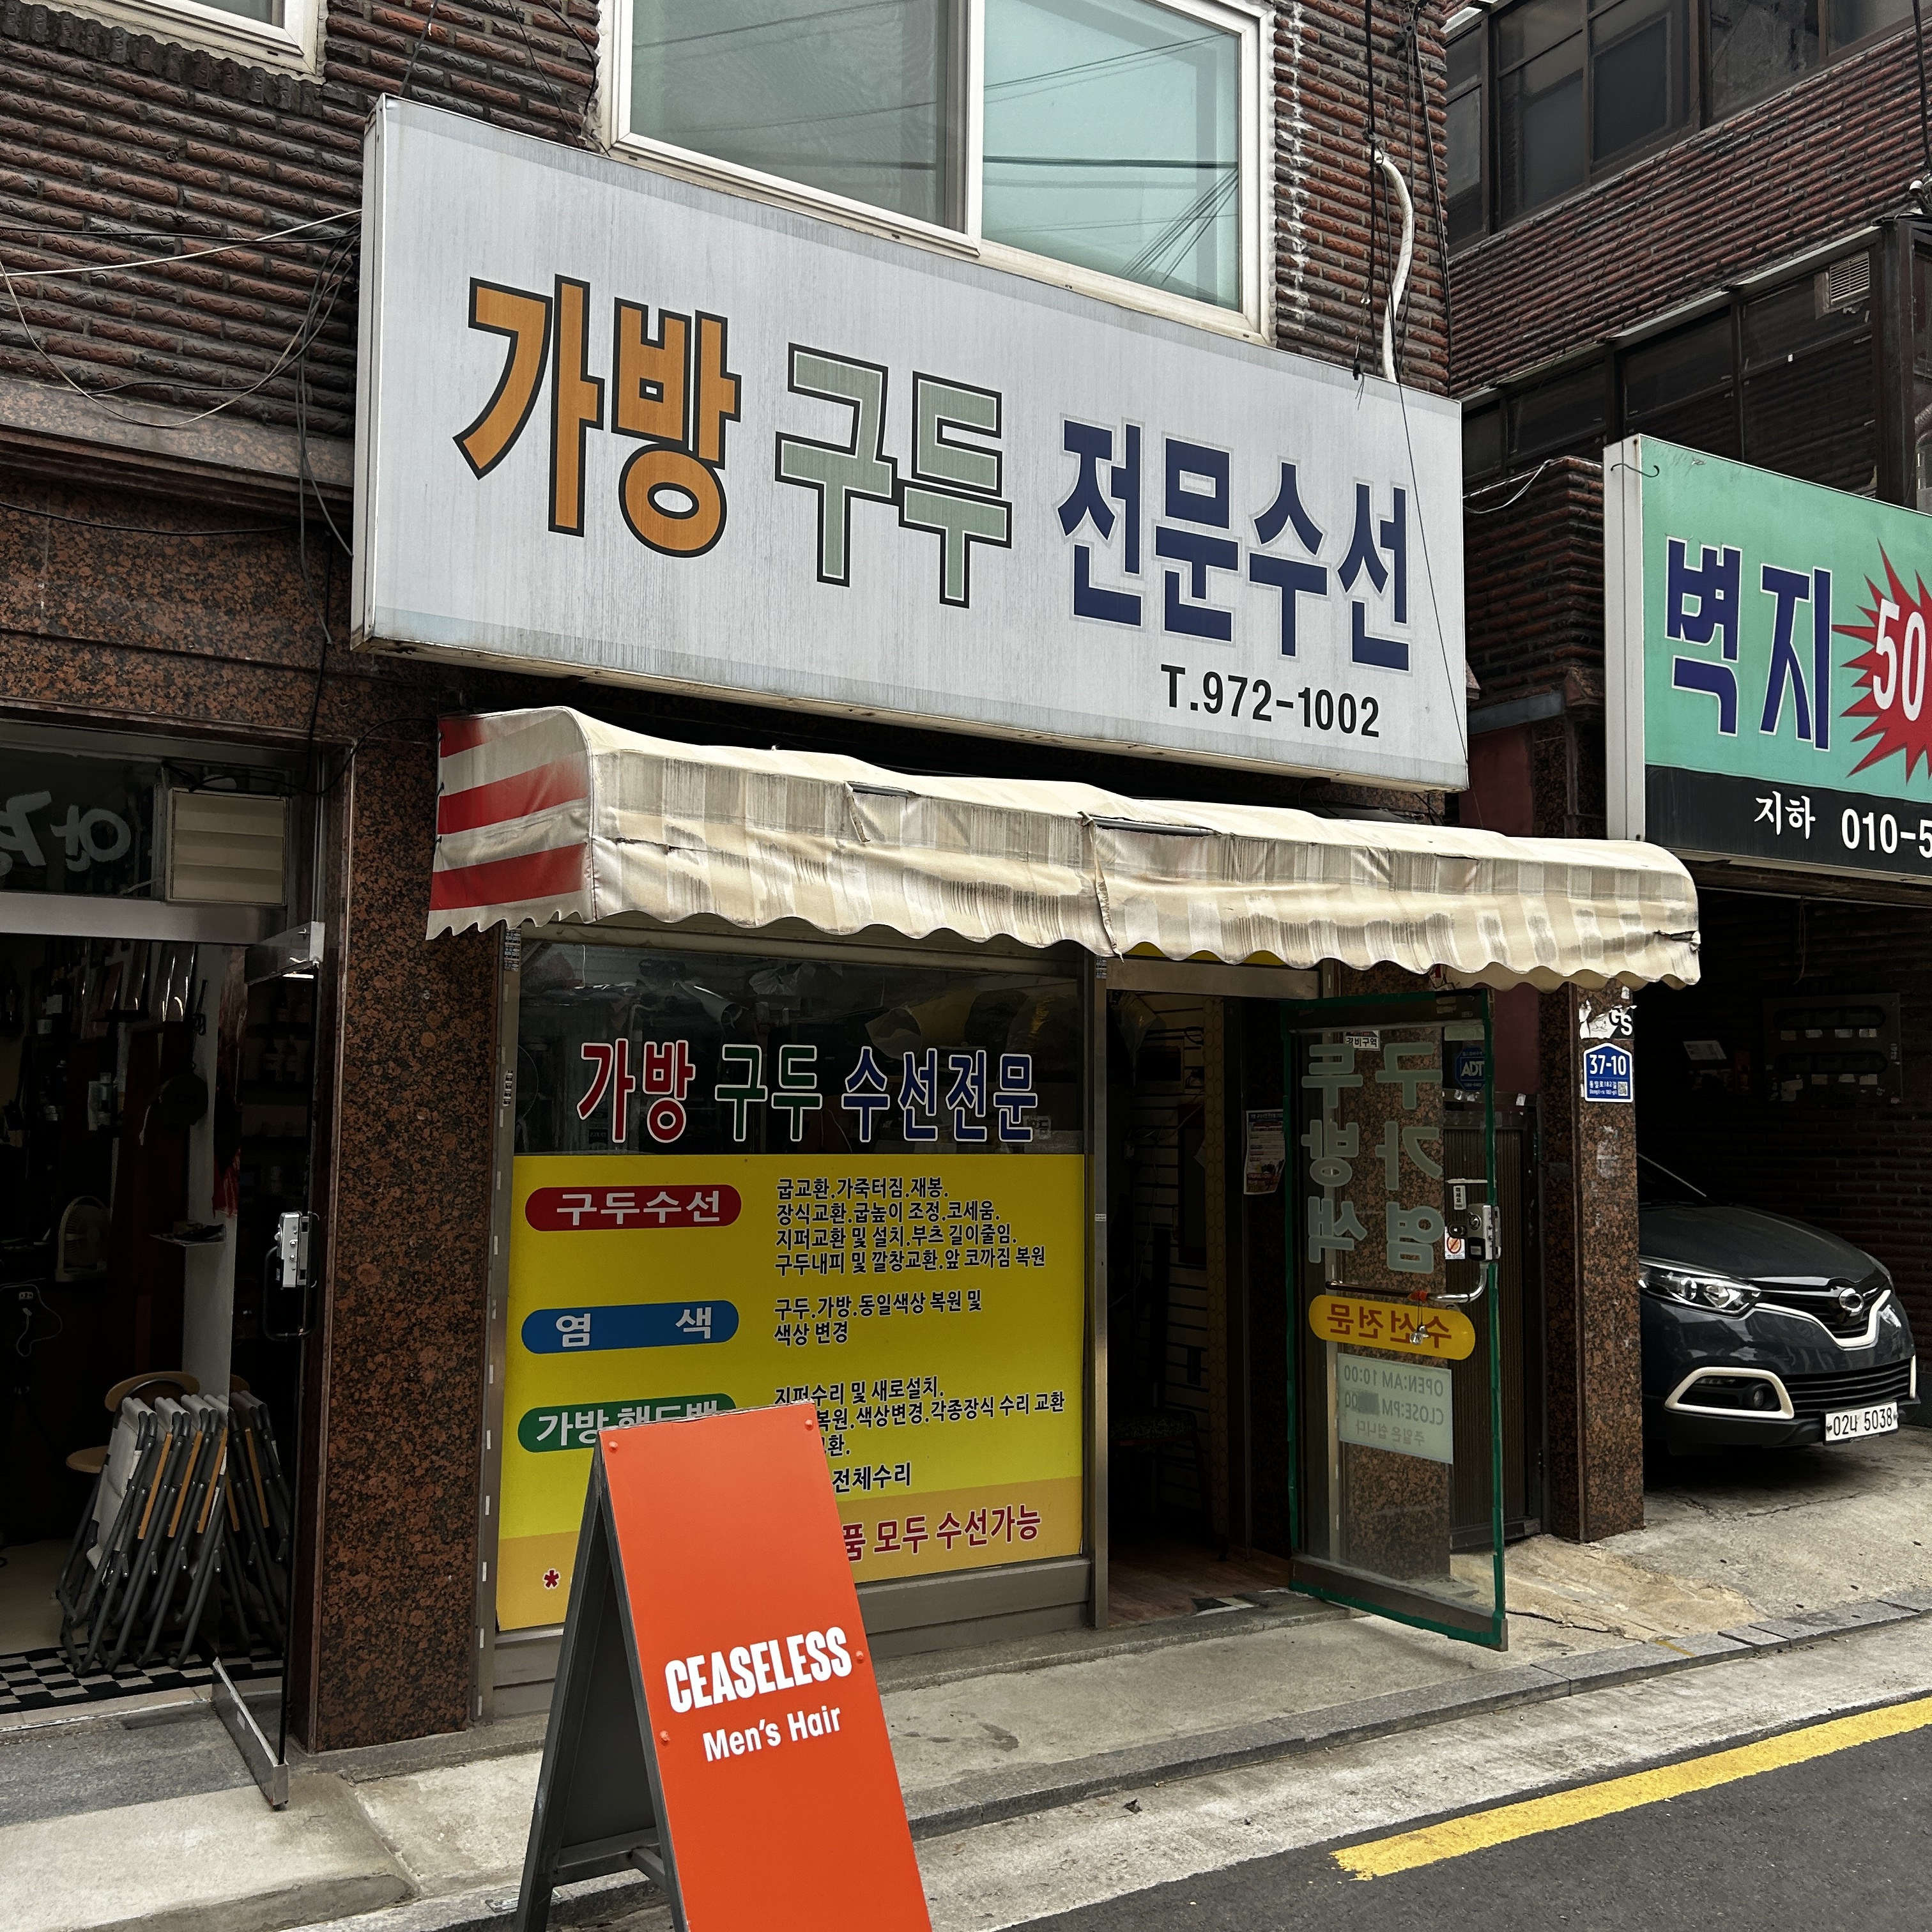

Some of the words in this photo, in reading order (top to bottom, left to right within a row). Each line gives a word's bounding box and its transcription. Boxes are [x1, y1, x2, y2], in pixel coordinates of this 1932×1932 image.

[452, 273, 742, 558] 가방
[774, 342, 1013, 610] 구두
[1665, 535, 1832, 752] 벽지
[1160, 663, 1380, 738] T.972-1002
[1754, 790, 1816, 839] 지하
[1460, 1061, 1485, 1077] ADT
[1589, 1054, 1627, 1075] 37-10
[576, 1038, 696, 1143] 가방
[714, 1043, 822, 1142] 구두
[556, 1190, 720, 1226] 구두수선
[774, 1227, 847, 1251] 지퍼교환
[851, 1226, 867, 1249] 및
[774, 1252, 845, 1276] 구두내피
[851, 1251, 867, 1274] 및
[1015, 1245, 1046, 1268] 복원
[930, 1290, 962, 1313] 복원
[967, 1289, 982, 1312] 및
[773, 1322, 811, 1347] 색상
[815, 1320, 848, 1344] 변경
[851, 1381, 866, 1404] 및
[999, 1393, 1029, 1416] 수리
[1034, 1391, 1065, 1413] 교환
[1864, 1407, 1892, 1431] 5038
[832, 1461, 911, 1494] 전체수리
[873, 1515, 929, 1554] 모두
[935, 1503, 1042, 1551] 수선가능
[664, 1627, 853, 1713] CEASELESS
[702, 1719, 781, 1763] Men's
[786, 1705, 841, 1742] Hair
